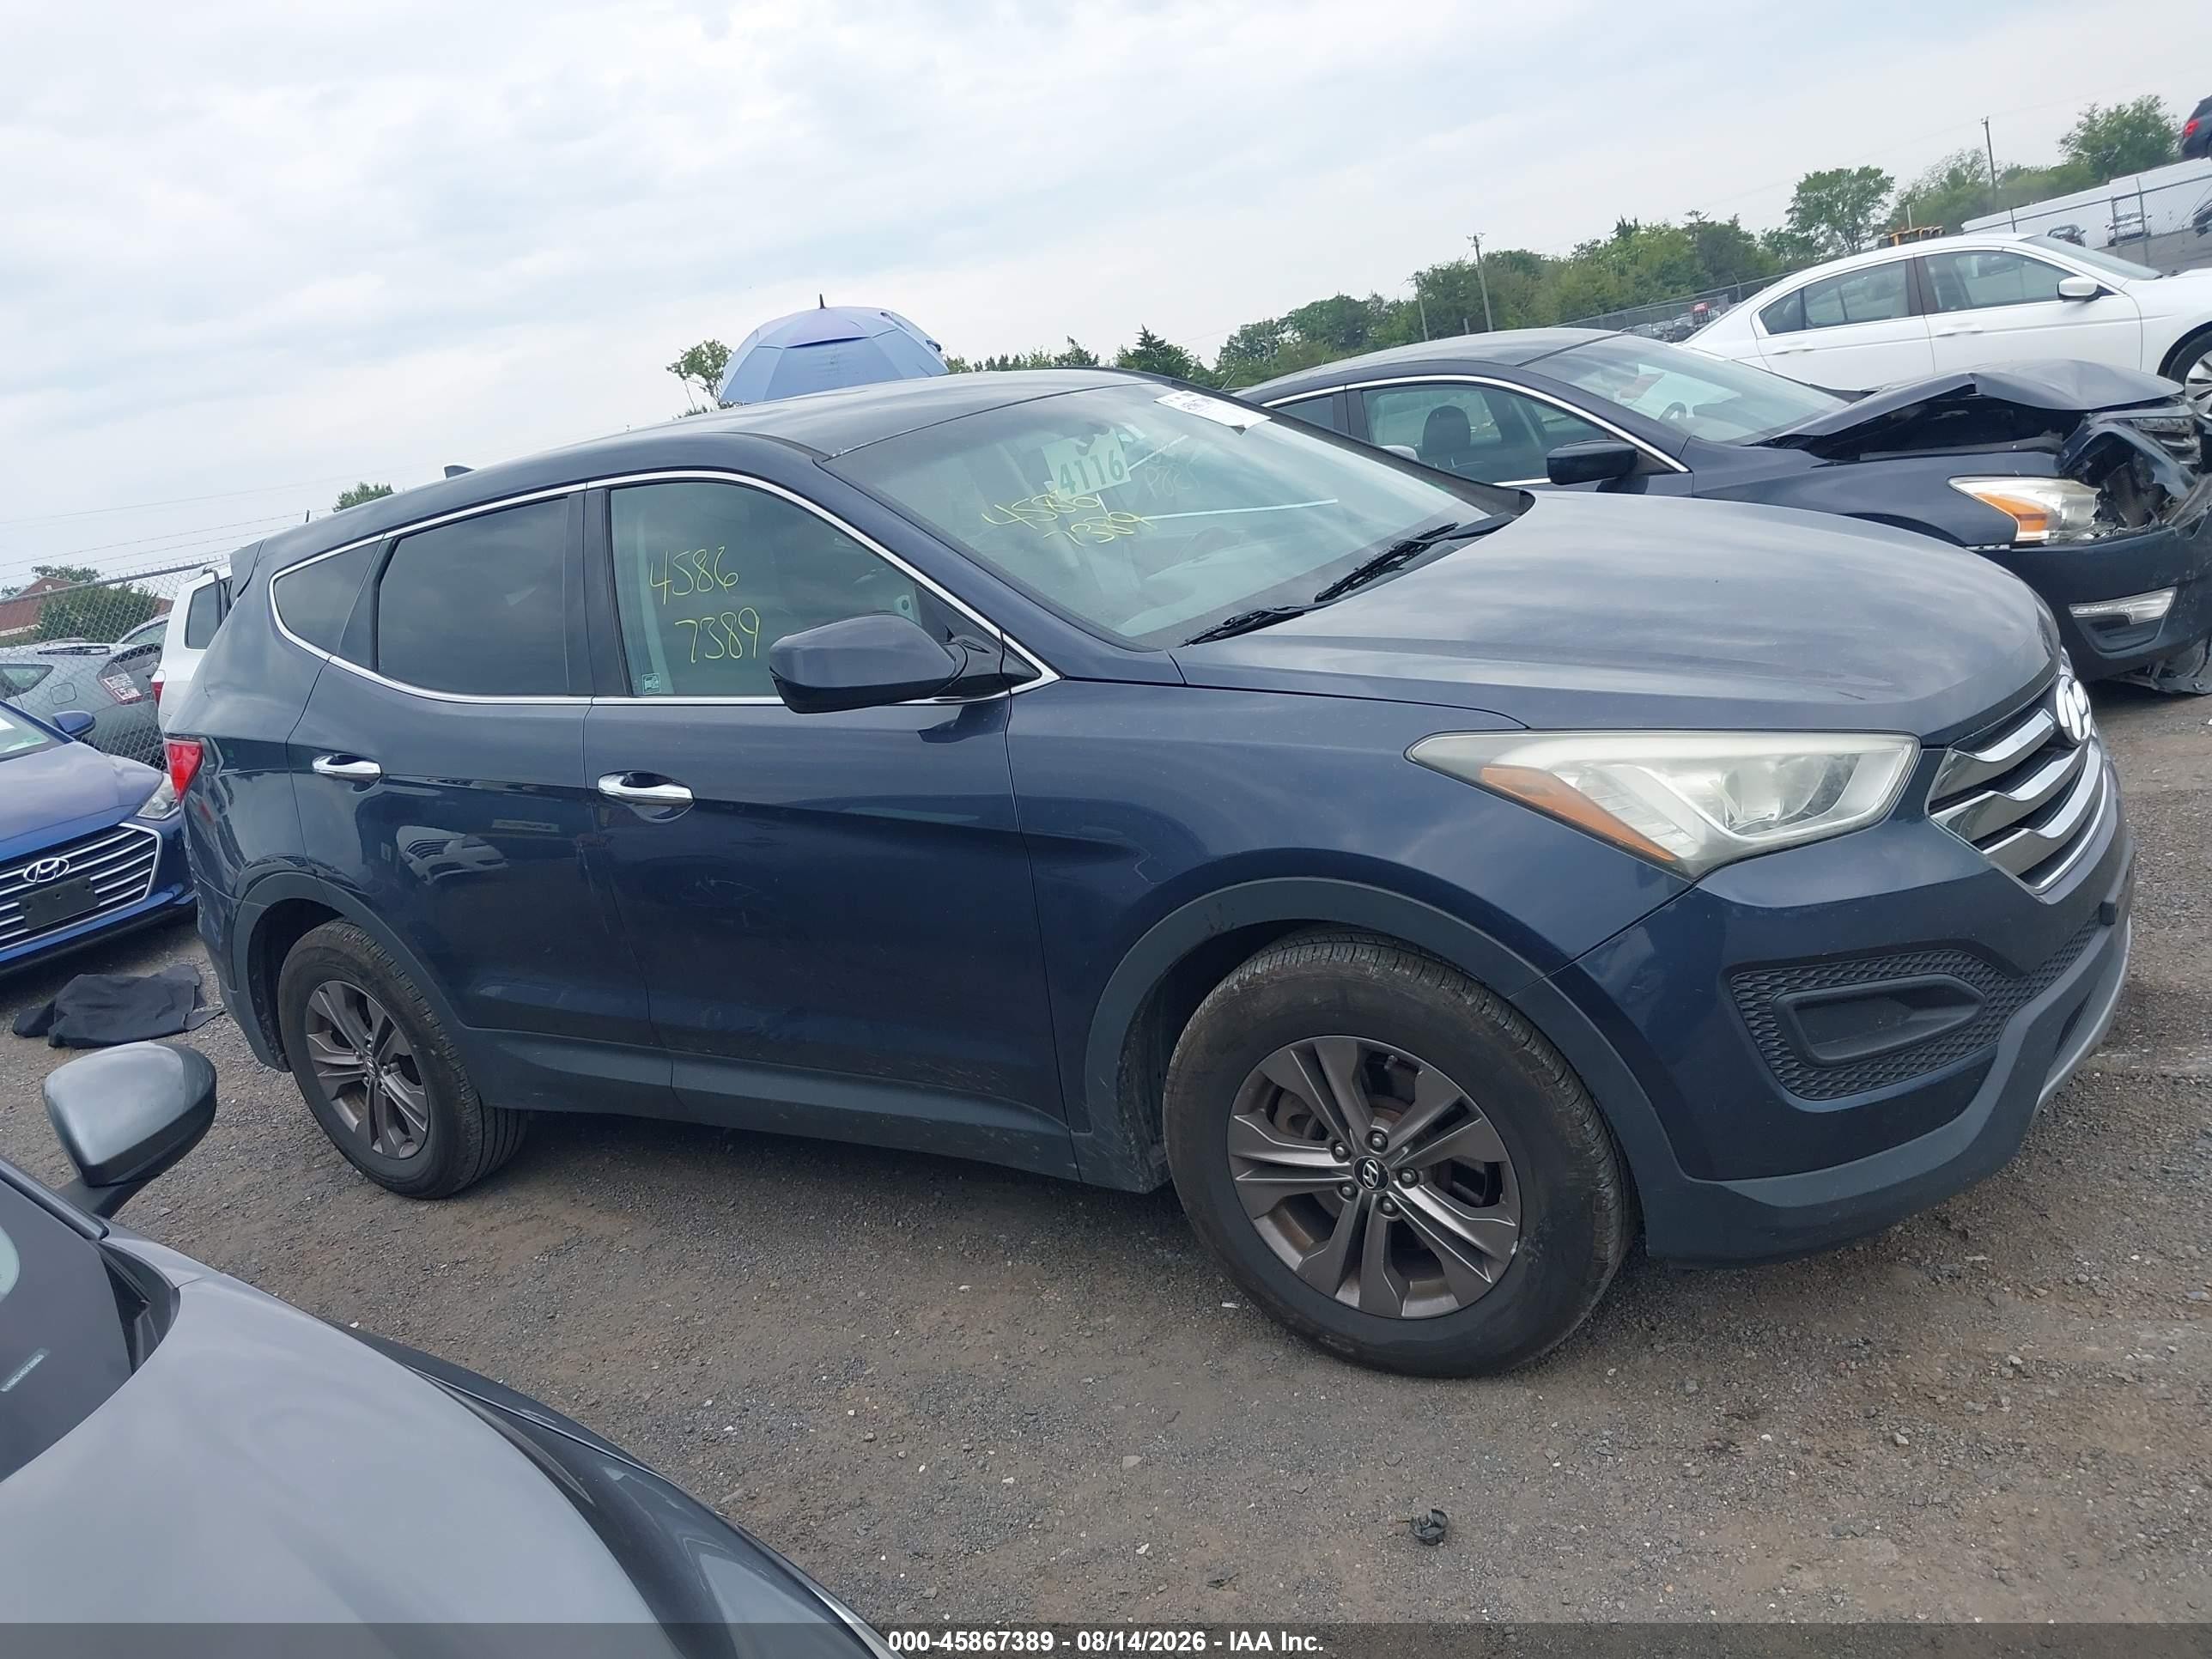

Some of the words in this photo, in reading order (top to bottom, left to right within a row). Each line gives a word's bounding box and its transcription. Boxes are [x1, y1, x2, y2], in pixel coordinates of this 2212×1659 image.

[1060, 449, 1125, 495] 4116
[649, 545, 739, 605] 4586
[674, 606, 761, 665] 7389
